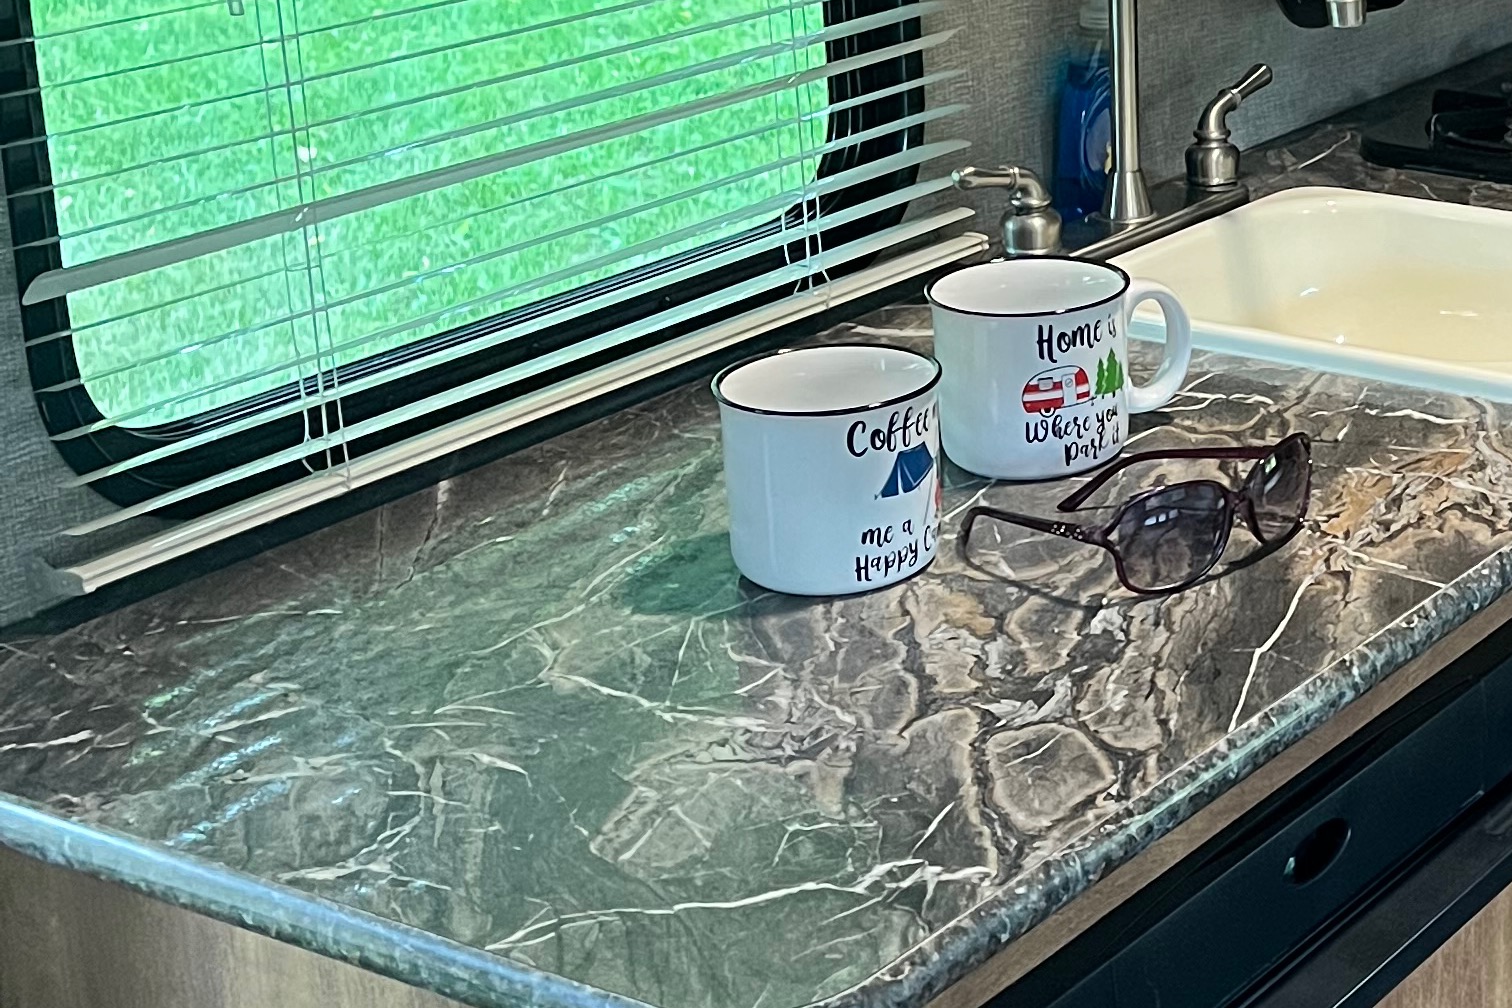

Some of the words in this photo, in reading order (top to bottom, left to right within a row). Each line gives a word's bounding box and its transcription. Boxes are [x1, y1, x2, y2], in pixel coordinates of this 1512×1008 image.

[1036, 320, 1102, 363] Home
[1107, 314, 1116, 338] is
[847, 406, 929, 457] Coffee
[1025, 414, 1091, 443] Where
[1096, 405, 1119, 435] you
[1112, 421, 1120, 444] it
[861, 525, 894, 547] me
[902, 519, 913, 535] a
[855, 539, 918, 582] Happy
